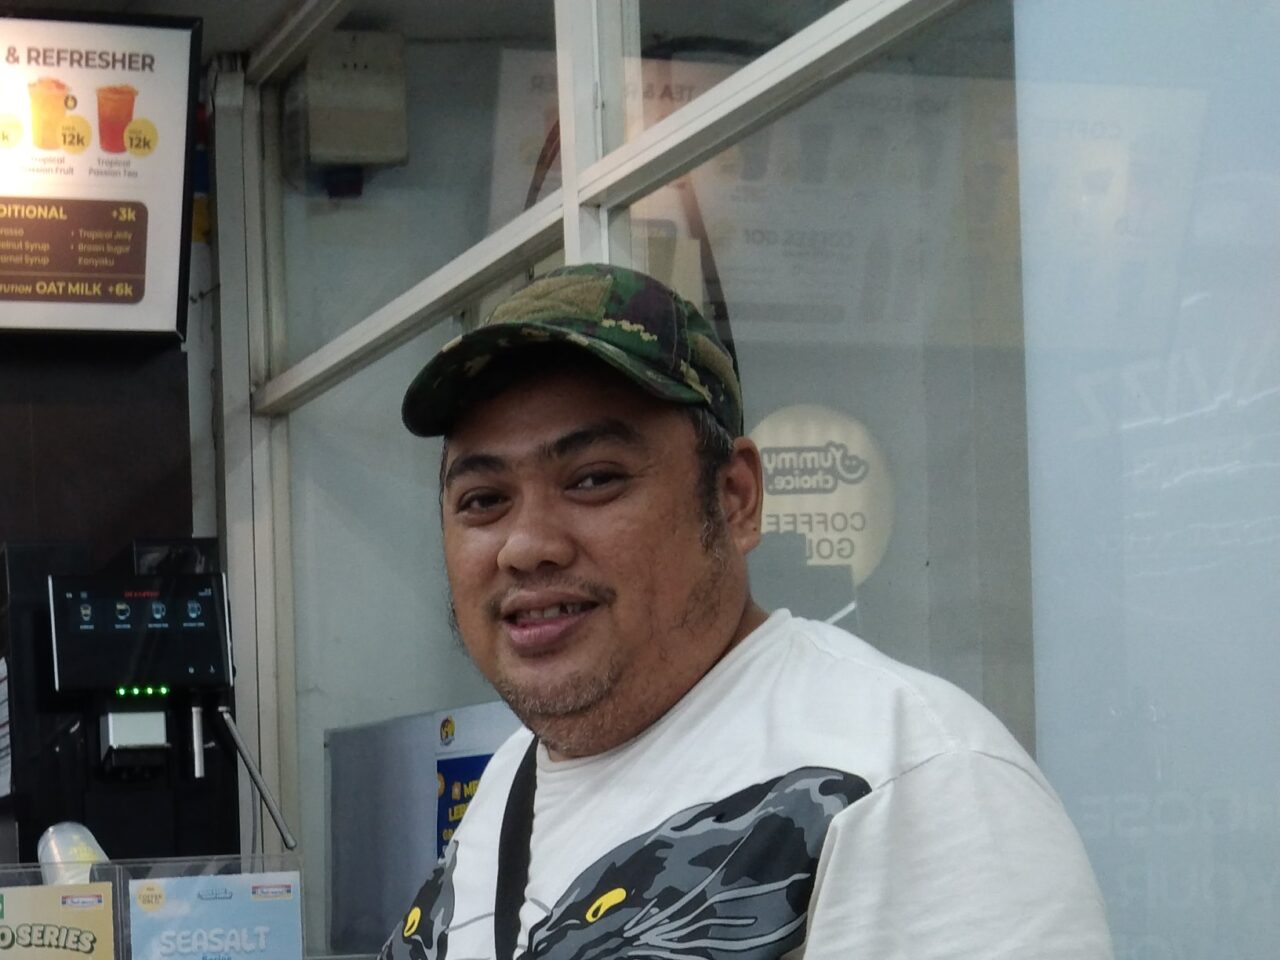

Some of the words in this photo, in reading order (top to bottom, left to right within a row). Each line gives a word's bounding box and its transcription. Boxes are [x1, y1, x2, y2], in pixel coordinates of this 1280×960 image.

[5, 46, 21, 65] &
[27, 47, 156, 73] REFRESHER
[61, 131, 86, 147] 12k
[128, 135, 152, 150] 12k
[111, 207, 137, 223] +3k
[24, 240, 51, 252] Syrup
[24, 254, 51, 266] Syrup
[35, 281, 66, 295] OAT
[67, 282, 103, 297] MILK
[16, 923, 97, 954] SERIES
[159, 926, 271, 956] SEASALT
